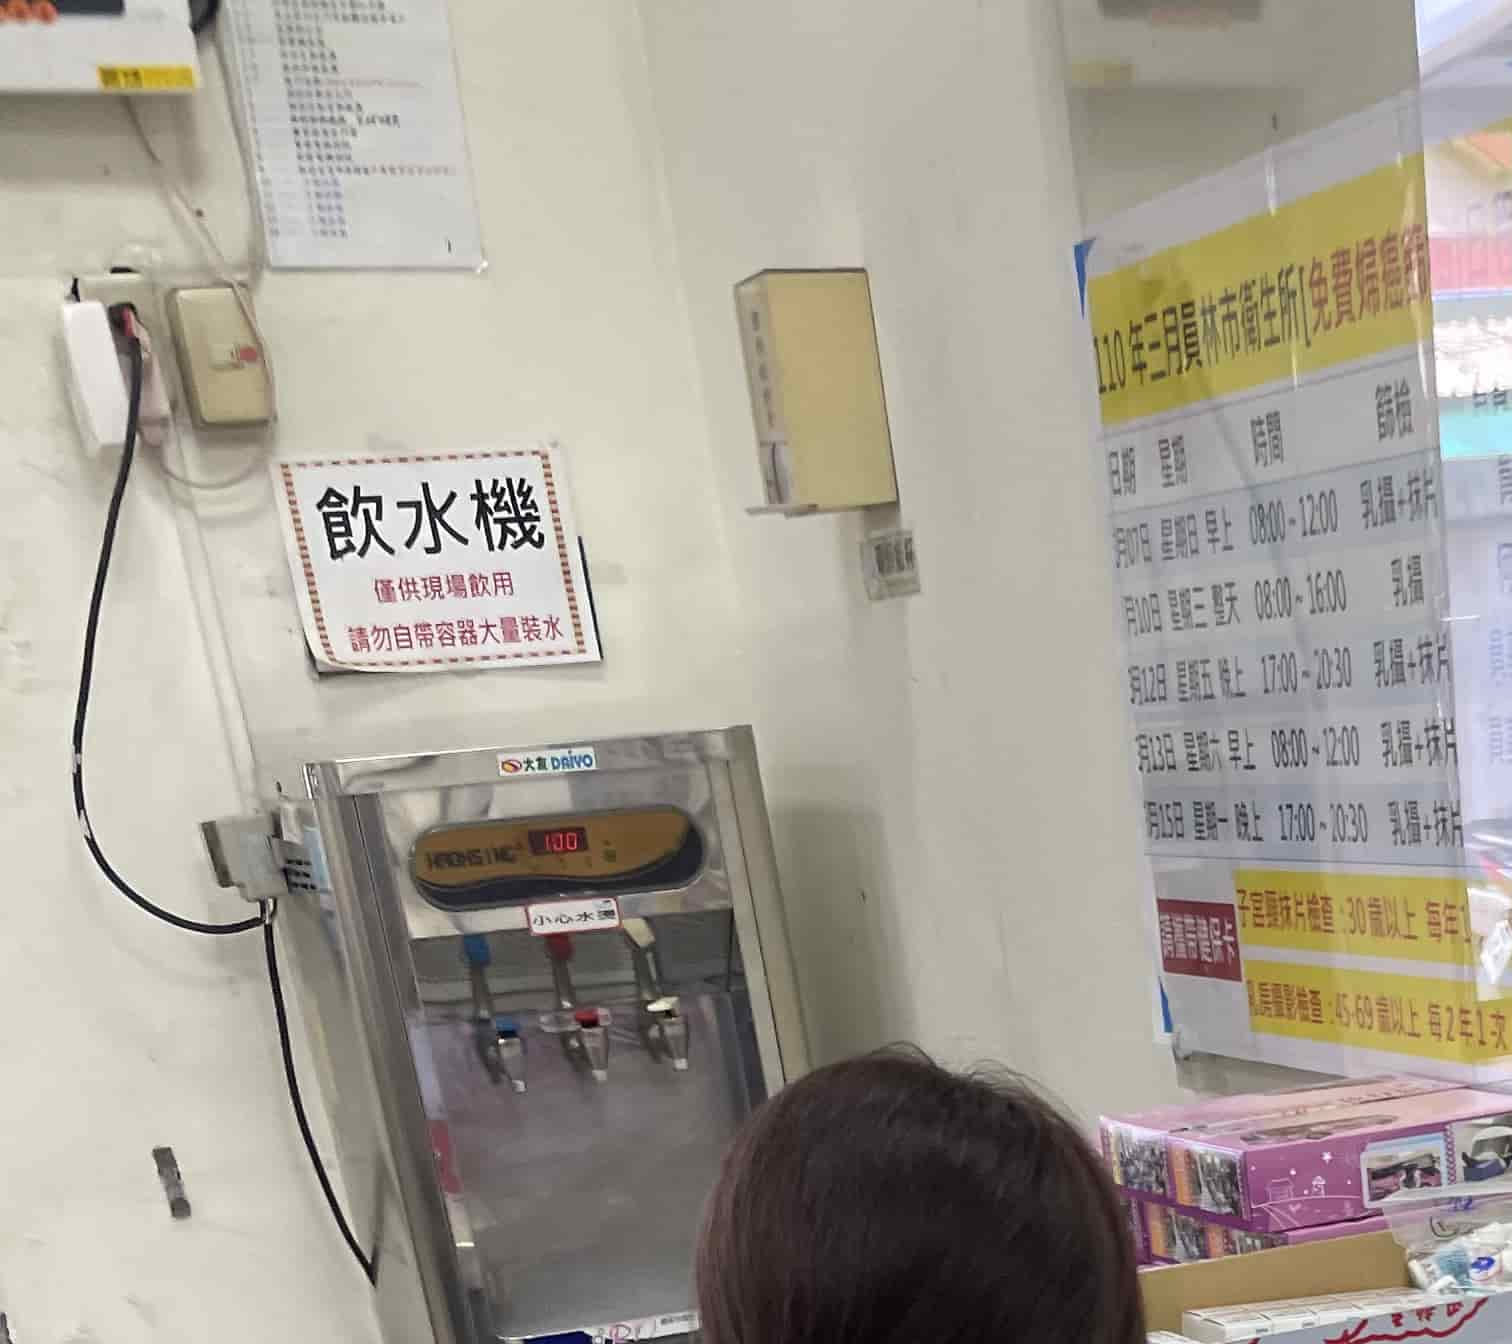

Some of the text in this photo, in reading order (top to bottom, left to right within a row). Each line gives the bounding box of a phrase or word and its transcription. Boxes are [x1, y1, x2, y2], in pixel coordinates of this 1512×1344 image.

[315, 477, 545, 560] 飲水機
[373, 571, 516, 604] 僅供現場飲用
[347, 612, 565, 653] 請勿自帶容器大量裝水
